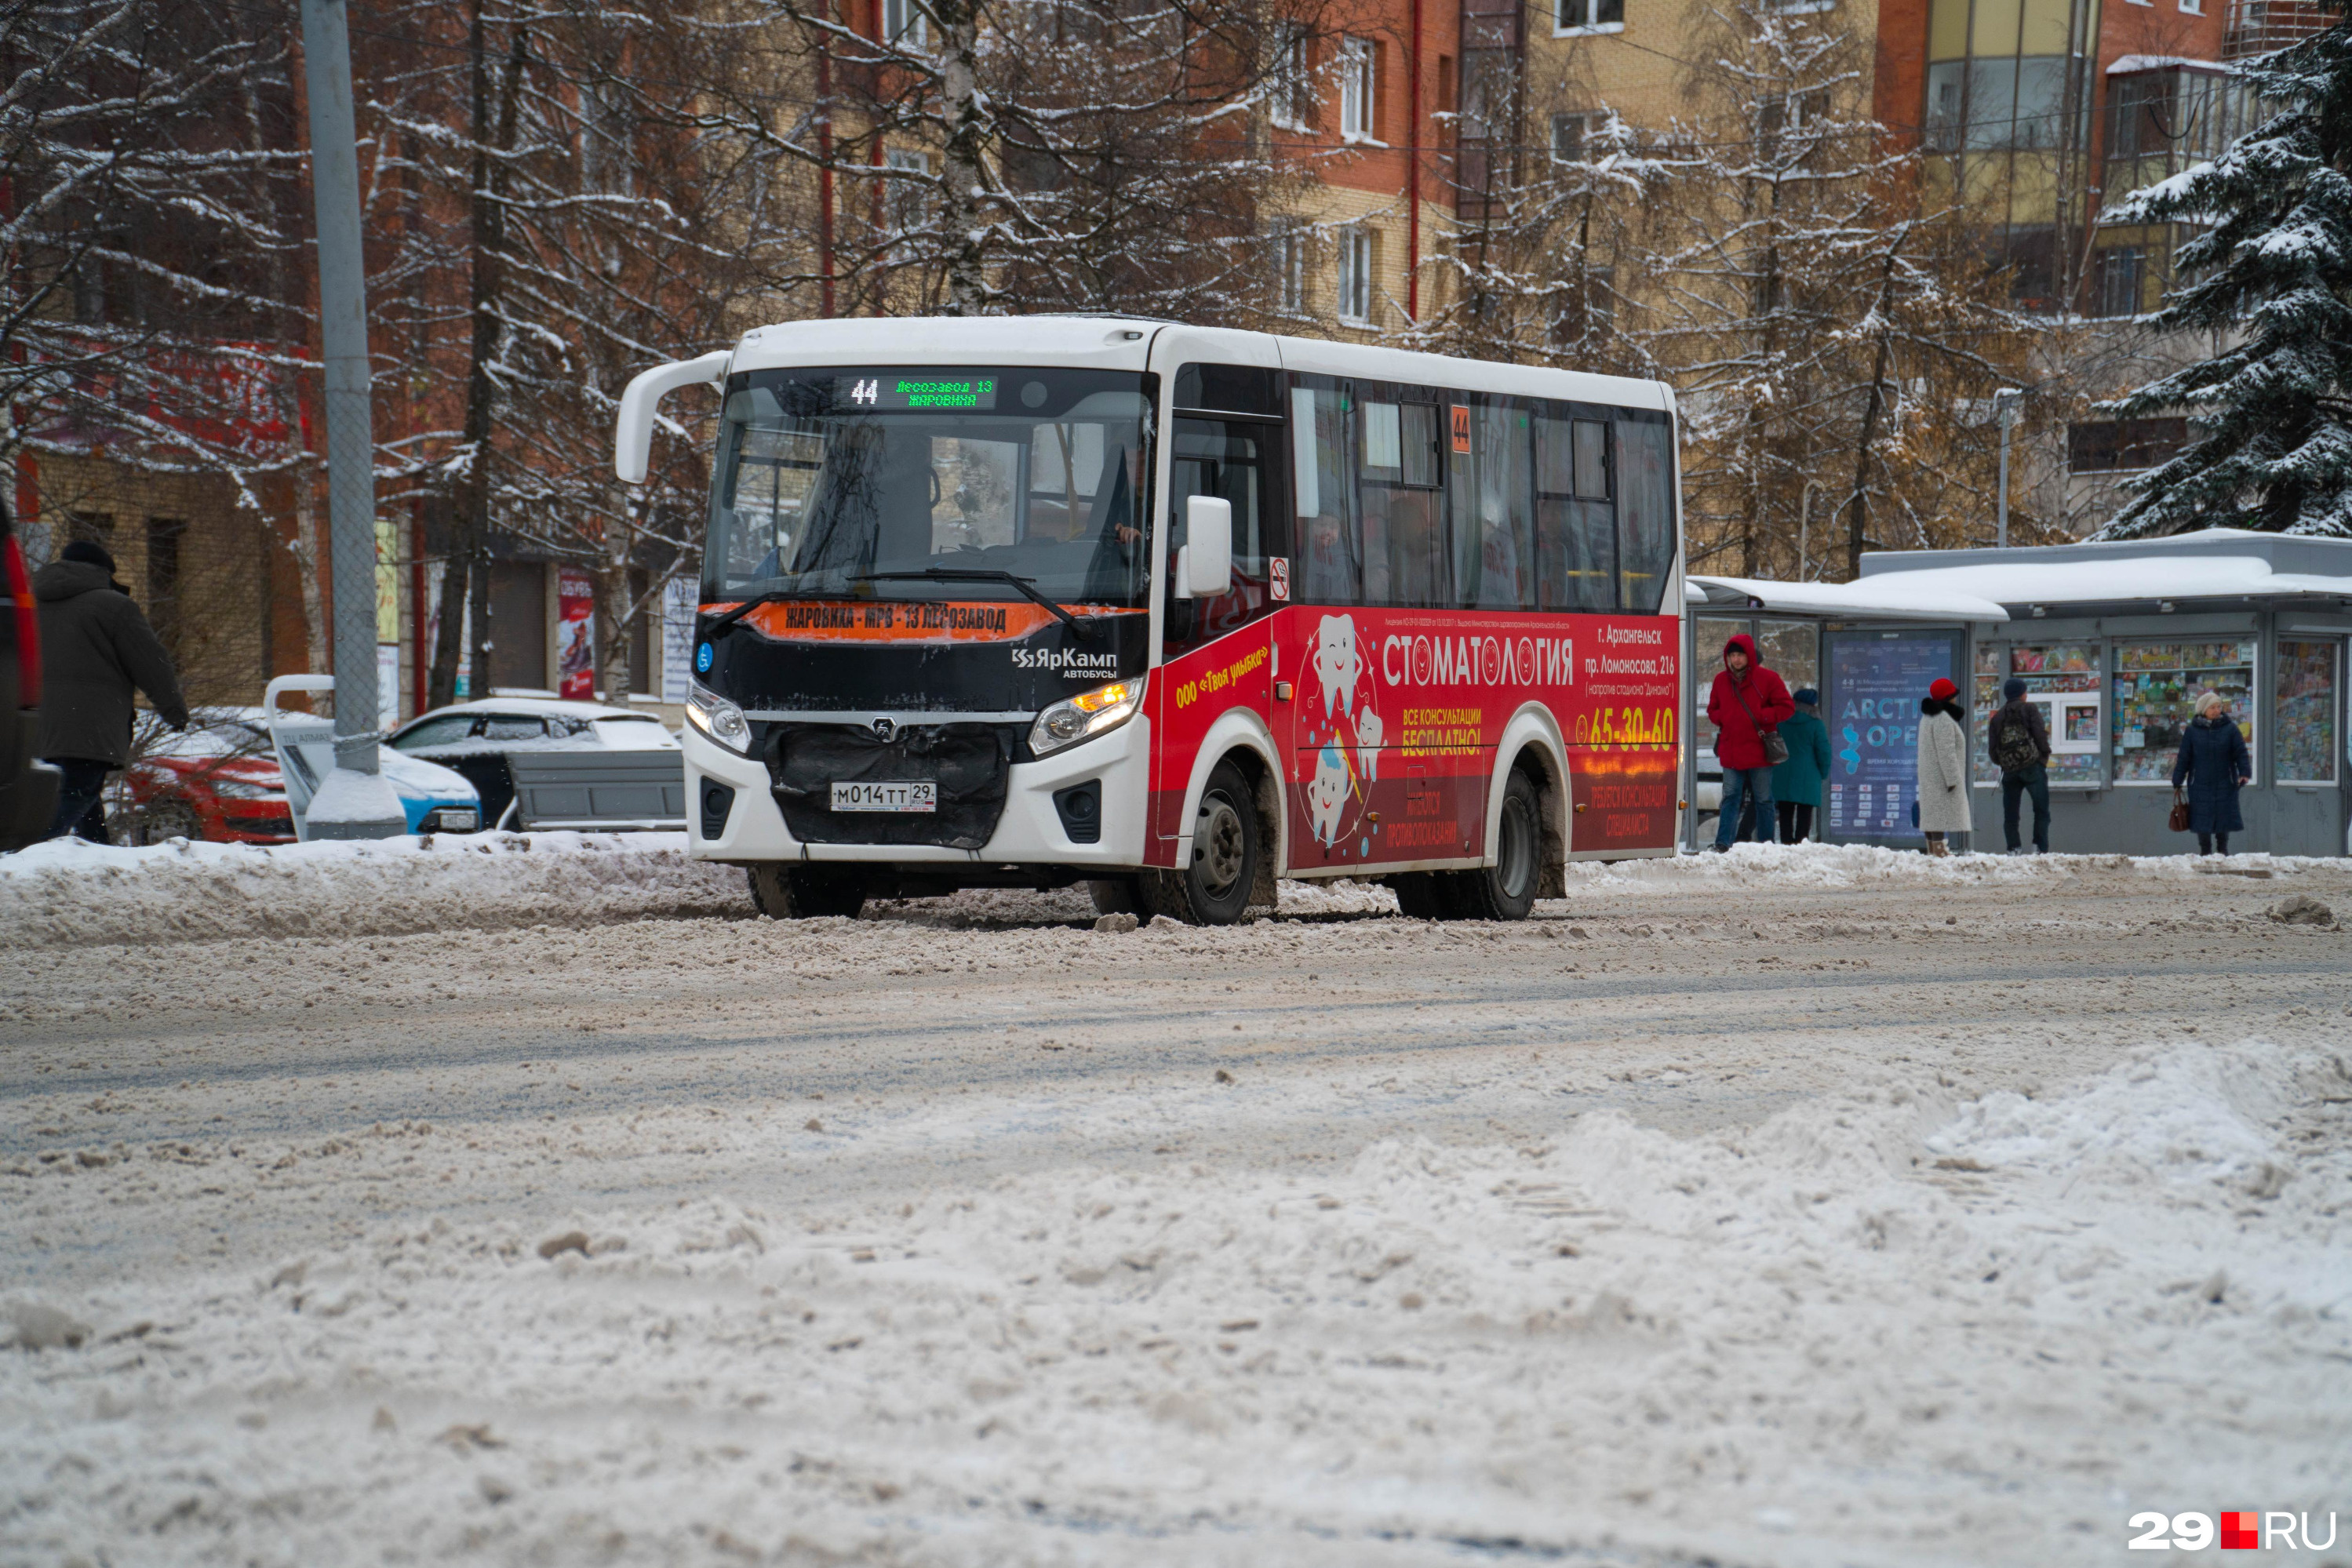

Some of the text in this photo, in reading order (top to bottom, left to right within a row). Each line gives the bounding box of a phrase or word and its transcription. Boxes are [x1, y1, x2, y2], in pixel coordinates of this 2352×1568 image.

[851, 379, 878, 405] 44
[896, 380, 993, 393] Лесозавод 13
[908, 395, 977, 406] ЖАРОВИХА
[1454, 414, 1469, 444] 44
[786, 607, 854, 628] ЖАРОВИХА
[865, 607, 894, 628] МРВ
[905, 607, 919, 629] 13
[921, 607, 1007, 633] ЛЕСОЗАВОД
[1597, 624, 1662, 648] г. Архангельск
[1036, 648, 1117, 670] ЯрКамп
[1383, 635, 1574, 686] СТОМАТОЛОГИЯ
[1586, 654, 1675, 678] пр. Ломоносова, 216
[1063, 670, 1117, 678] АВТОБУСЫ
[1176, 646, 1268, 709] ООО «Твоя улыбка»
[1616, 686, 1644, 697] стадиона
[1403, 708, 1481, 726] ВСЕ КОНСУЛЬТАЦИИ
[1590, 707, 1673, 752] 65-30-60
[1401, 728, 1481, 757] БЕСПЛАТНО!
[838, 785, 930, 803] М014ТТ 29
[1407, 791, 1440, 816] ИМЕЮТСЯ
[1591, 786, 1620, 809] ТРЕБУЕТСЯ
[1386, 820, 1457, 848] ПРОТИВОПОКАЗАНИЯ
[1607, 813, 1648, 838] СПЕЦИАЛИСТА
